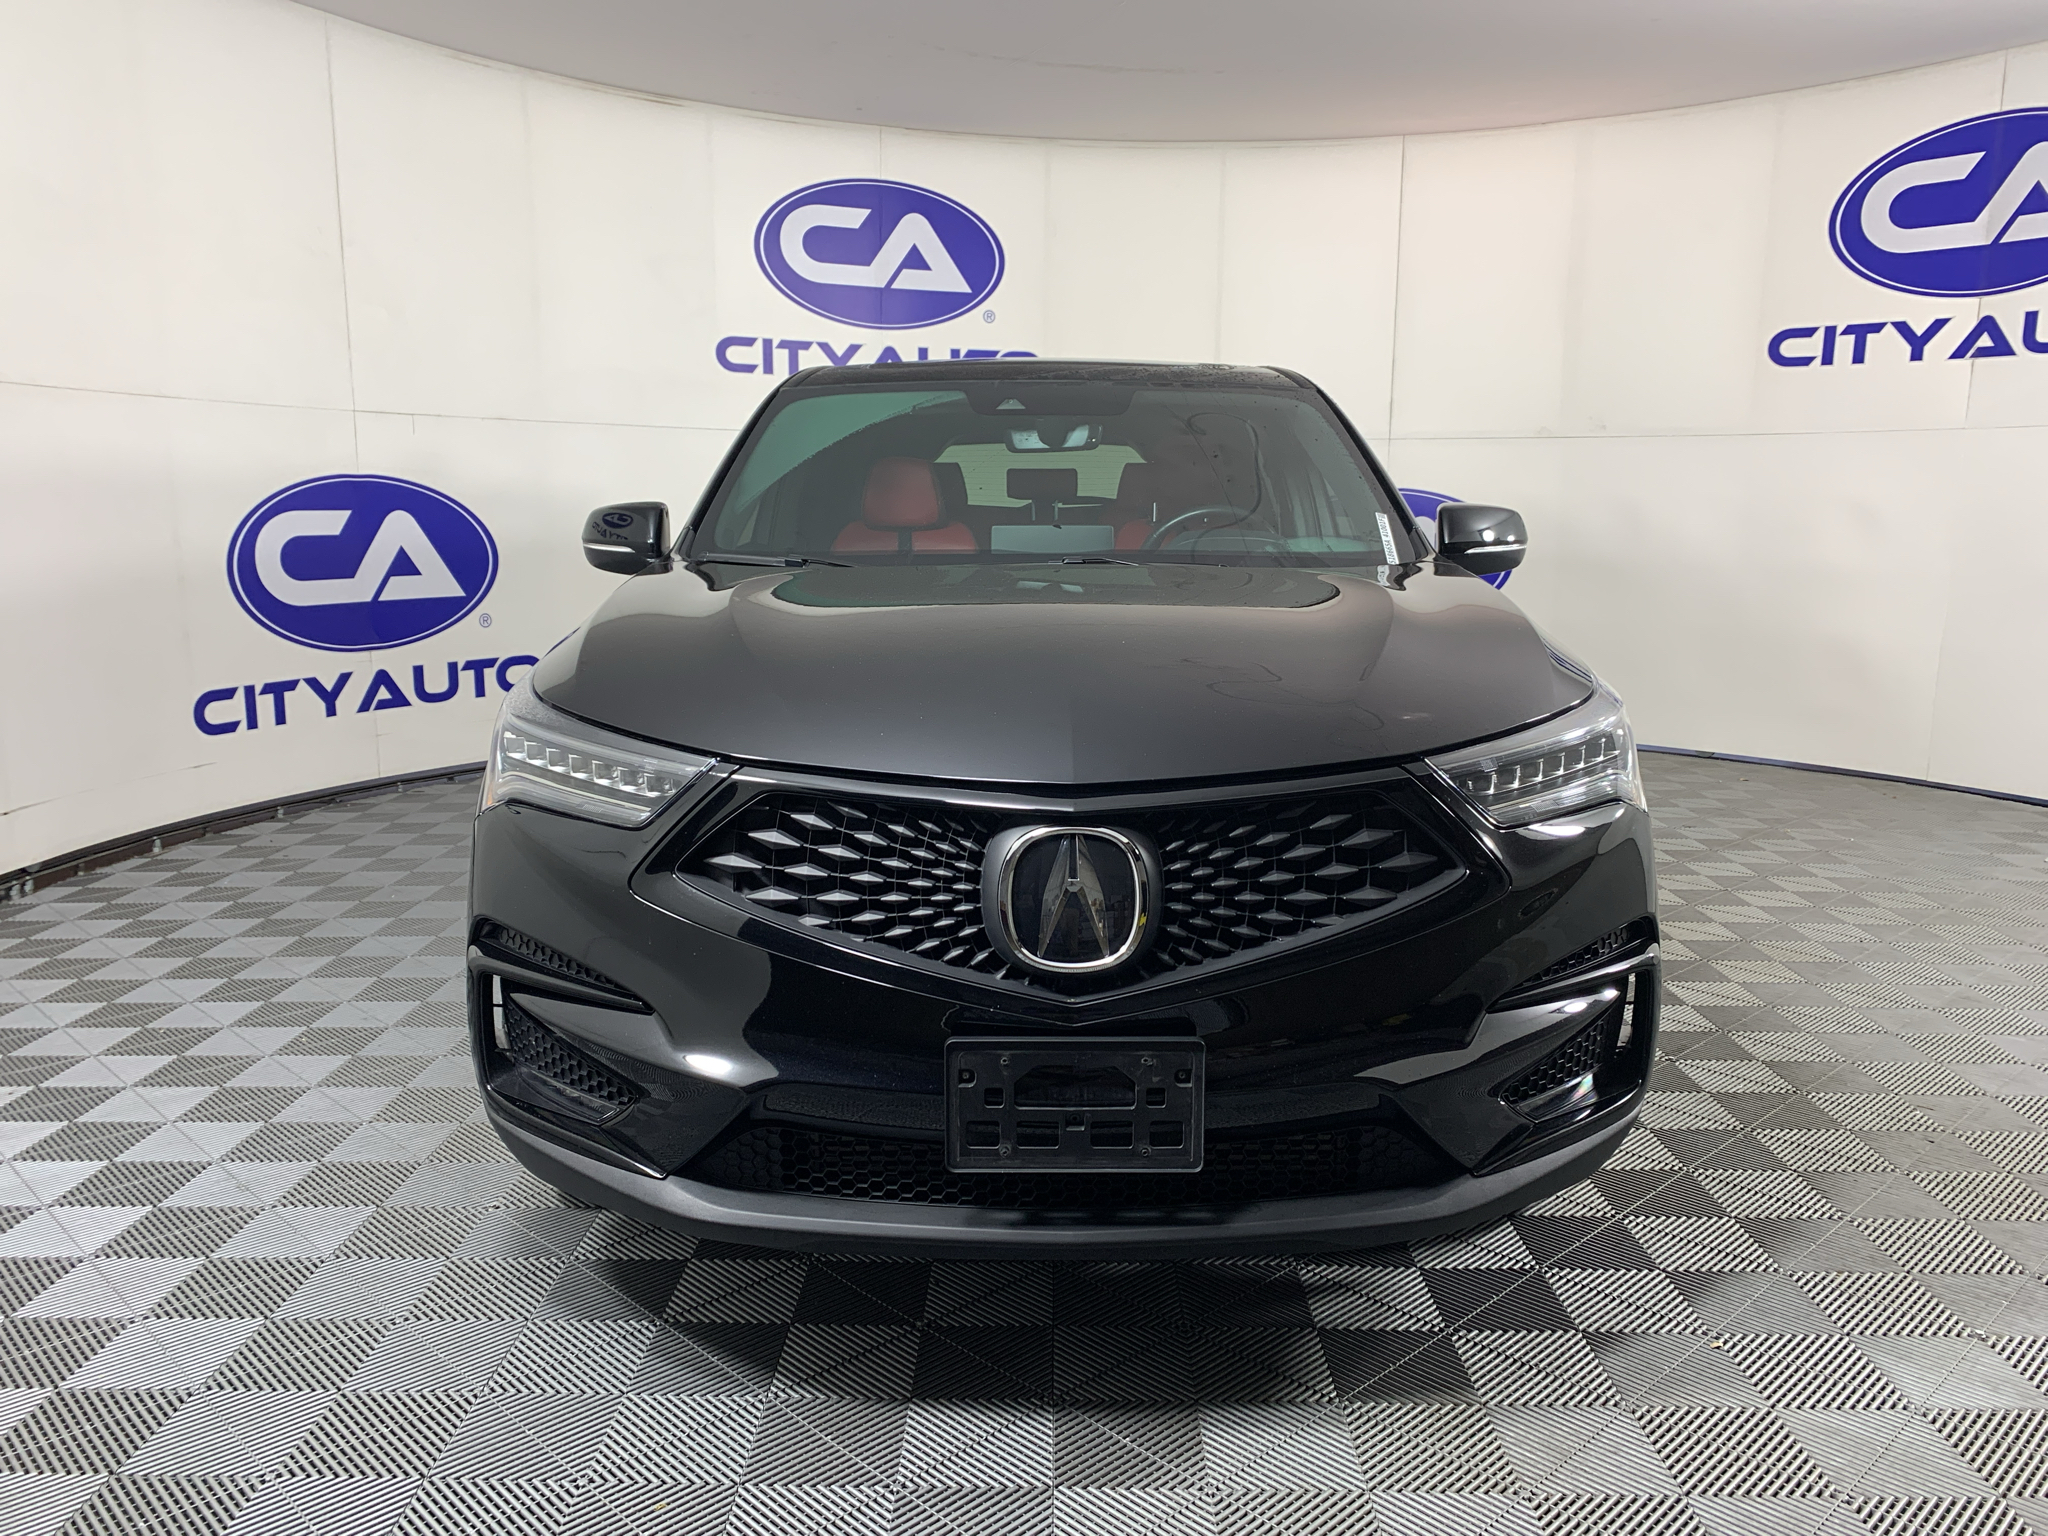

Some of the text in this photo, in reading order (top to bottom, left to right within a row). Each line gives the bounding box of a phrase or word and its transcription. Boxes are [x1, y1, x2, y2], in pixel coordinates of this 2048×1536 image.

[779, 204, 973, 293] CA
[1768, 316, 1954, 367] CITY
[255, 509, 466, 606] CA
[193, 671, 354, 736] CITY
